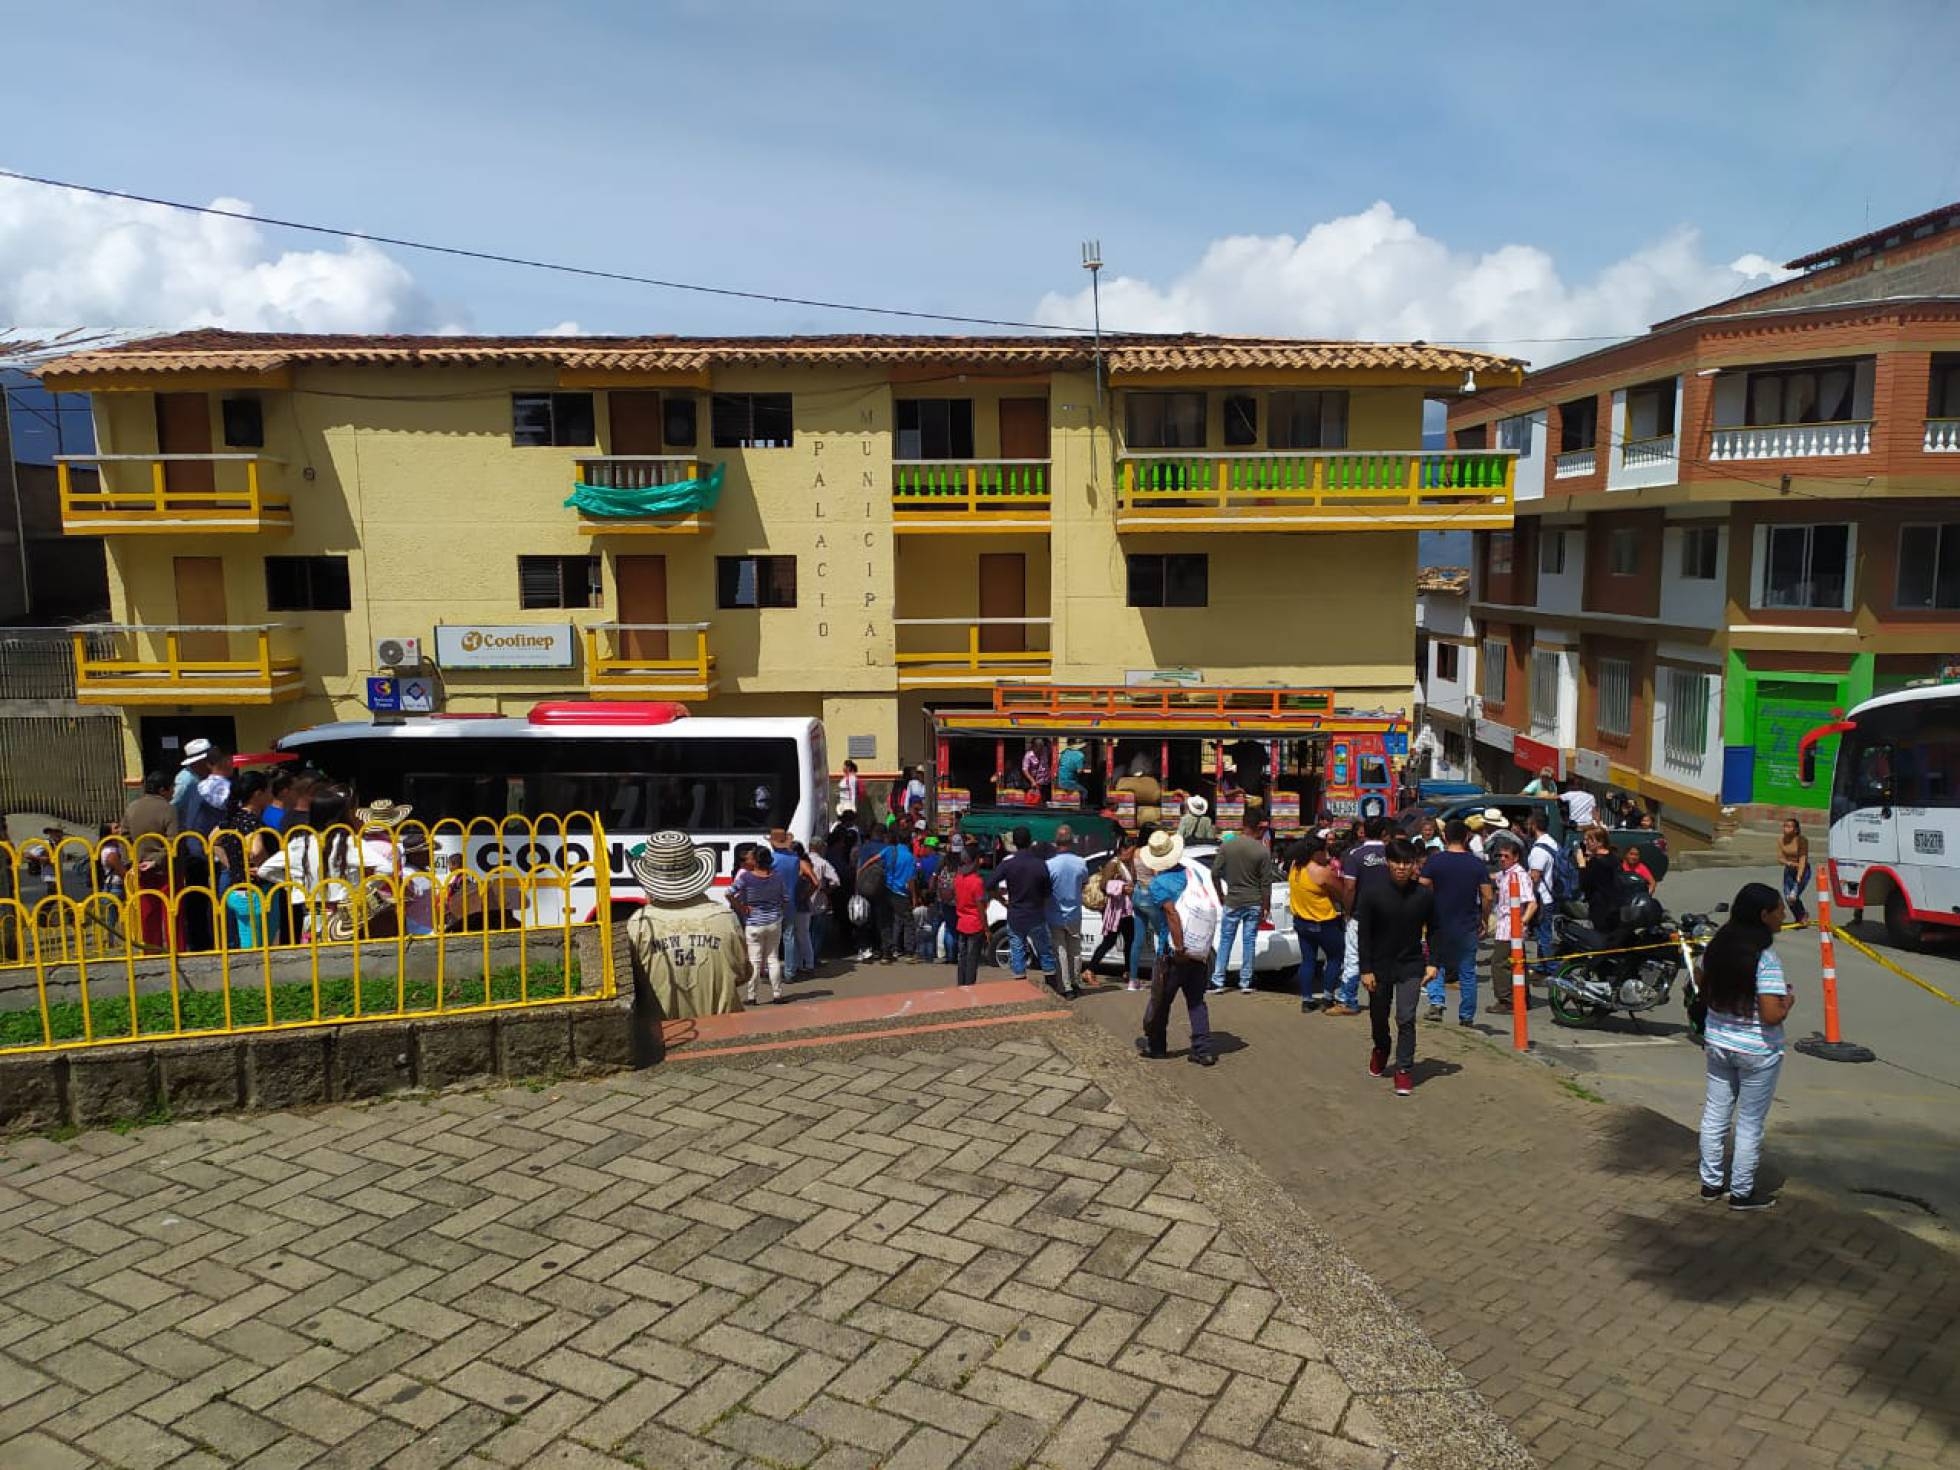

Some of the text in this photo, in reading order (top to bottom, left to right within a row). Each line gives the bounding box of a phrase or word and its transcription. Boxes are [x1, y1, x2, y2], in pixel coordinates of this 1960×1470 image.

[813, 441, 829, 637] PALACIO
[861, 409, 877, 666] MUNICIPAL
[484, 634, 554, 650] Coofinep
[475, 842, 760, 874] COONT
[688, 934, 721, 949] TIME
[675, 948, 696, 967] 54
